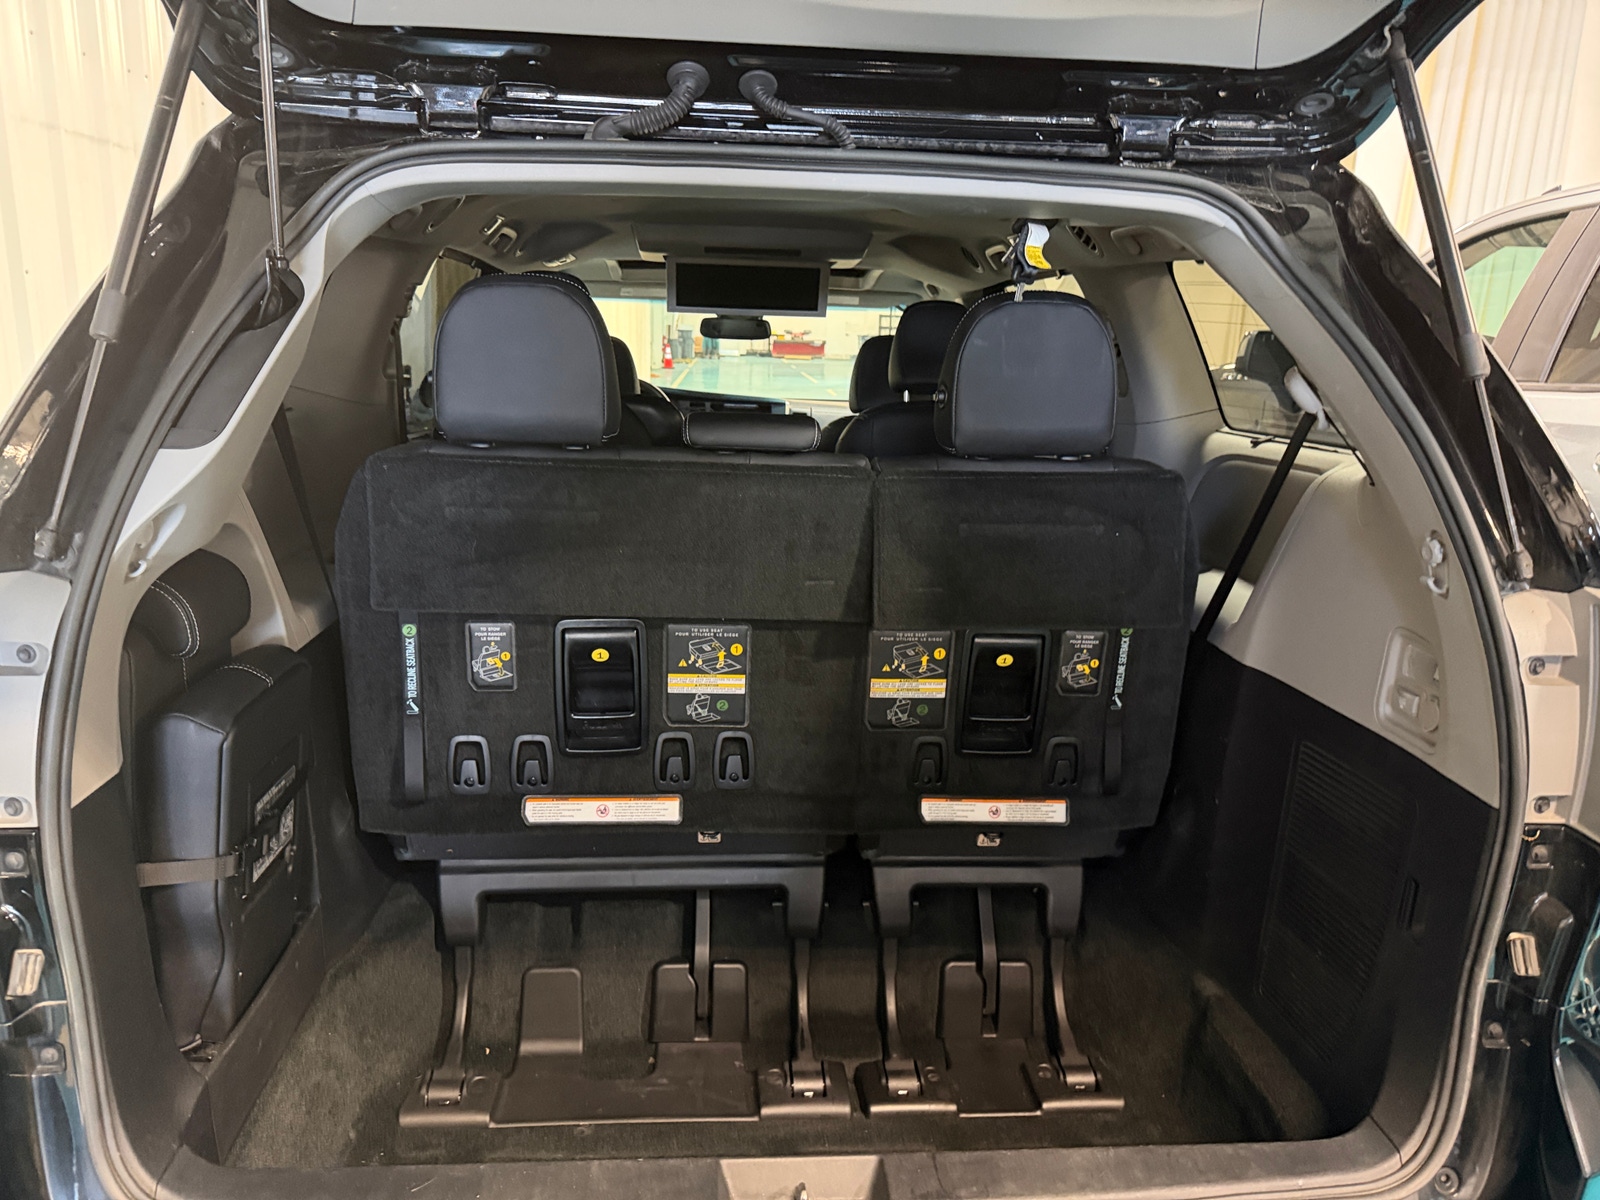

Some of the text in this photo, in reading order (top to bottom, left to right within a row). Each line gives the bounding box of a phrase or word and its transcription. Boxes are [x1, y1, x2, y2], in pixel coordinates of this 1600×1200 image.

[1118, 636, 1130, 665] SEATBACK
[405, 638, 418, 698] TO RECLINE SEATBACK
[1116, 665, 1126, 686] RECLINE
